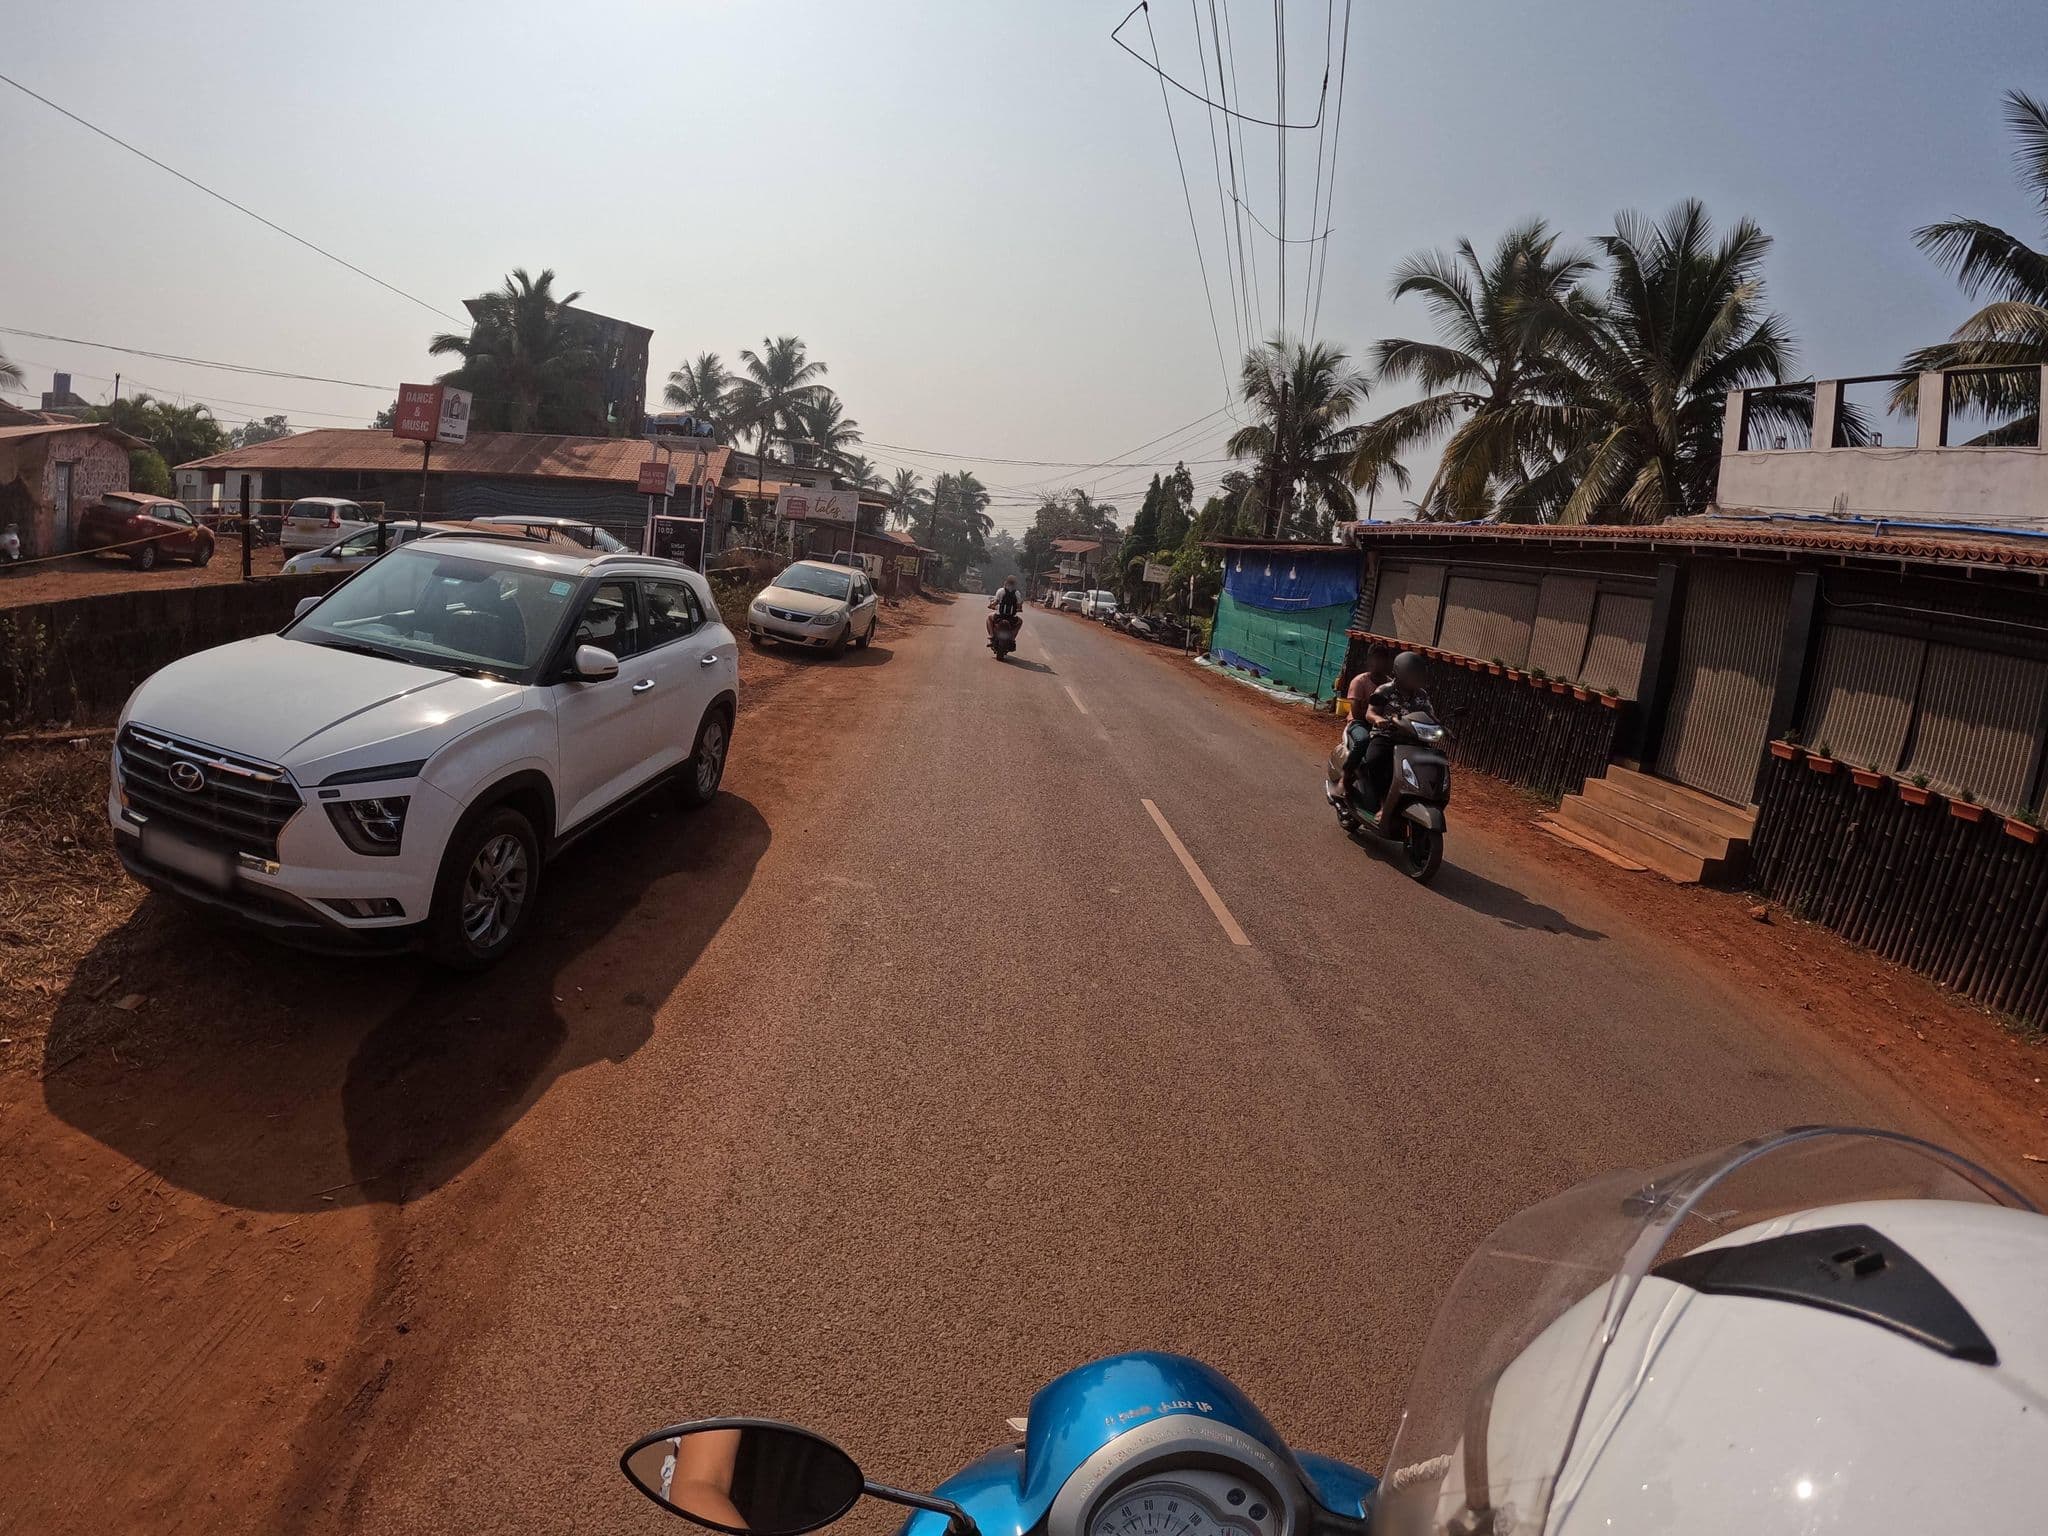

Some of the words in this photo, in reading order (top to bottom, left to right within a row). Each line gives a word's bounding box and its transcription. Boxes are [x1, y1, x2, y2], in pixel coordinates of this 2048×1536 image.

[406, 392, 434, 403] DANCE
[414, 406, 421, 417] &
[402, 419, 429, 431] MUSIC
[1144, 1499, 1153, 1510] 60
[1168, 1500, 1179, 1512] 80
[1121, 1505, 1132, 1517] 40
[1189, 1512, 1202, 1526] 100
[1103, 1522, 1115, 1534] 20
